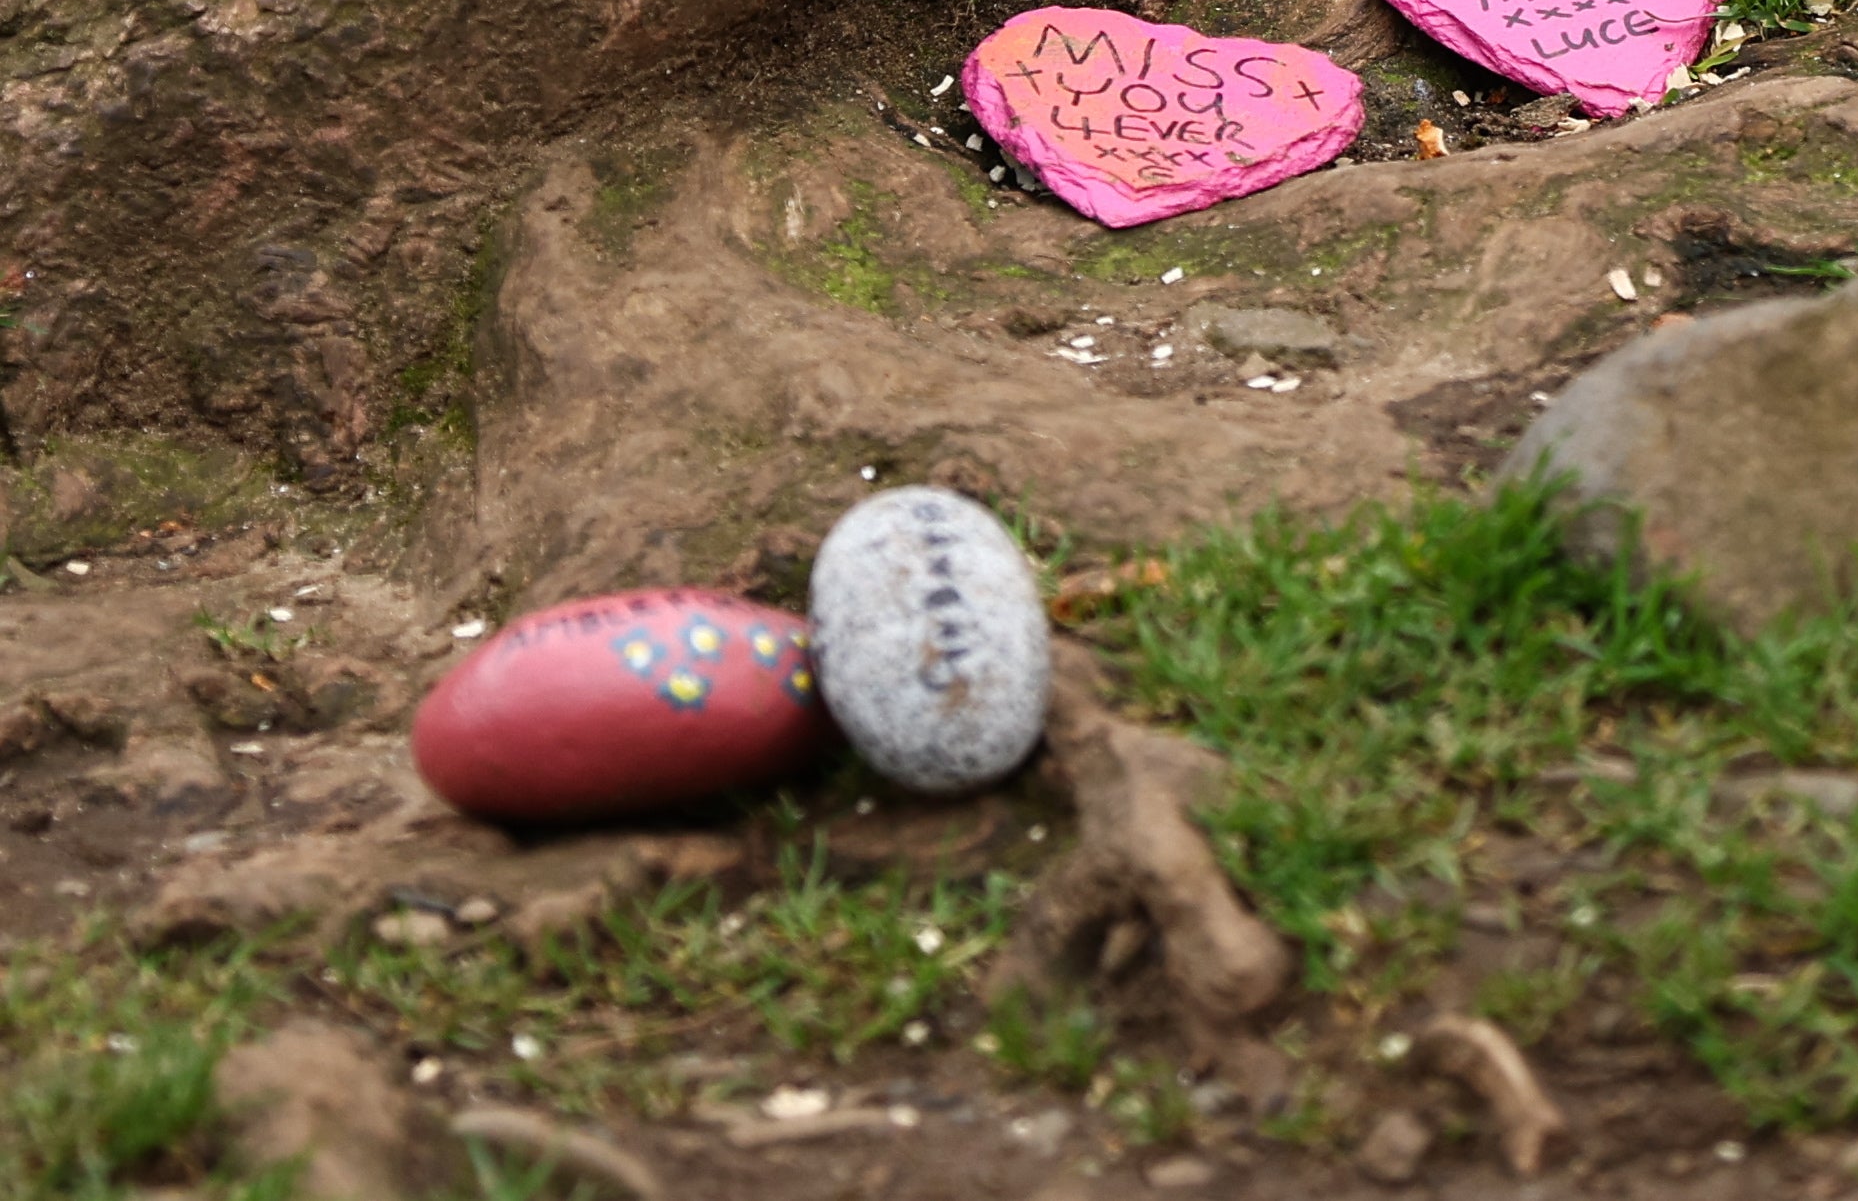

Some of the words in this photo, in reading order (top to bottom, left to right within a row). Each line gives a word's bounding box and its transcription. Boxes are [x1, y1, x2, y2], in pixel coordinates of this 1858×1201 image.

[1531, 10, 1661, 60] LUCE
[1033, 24, 1286, 97] MISS
[1056, 72, 1226, 119] YOU
[1051, 105, 1255, 151] 4EVER
